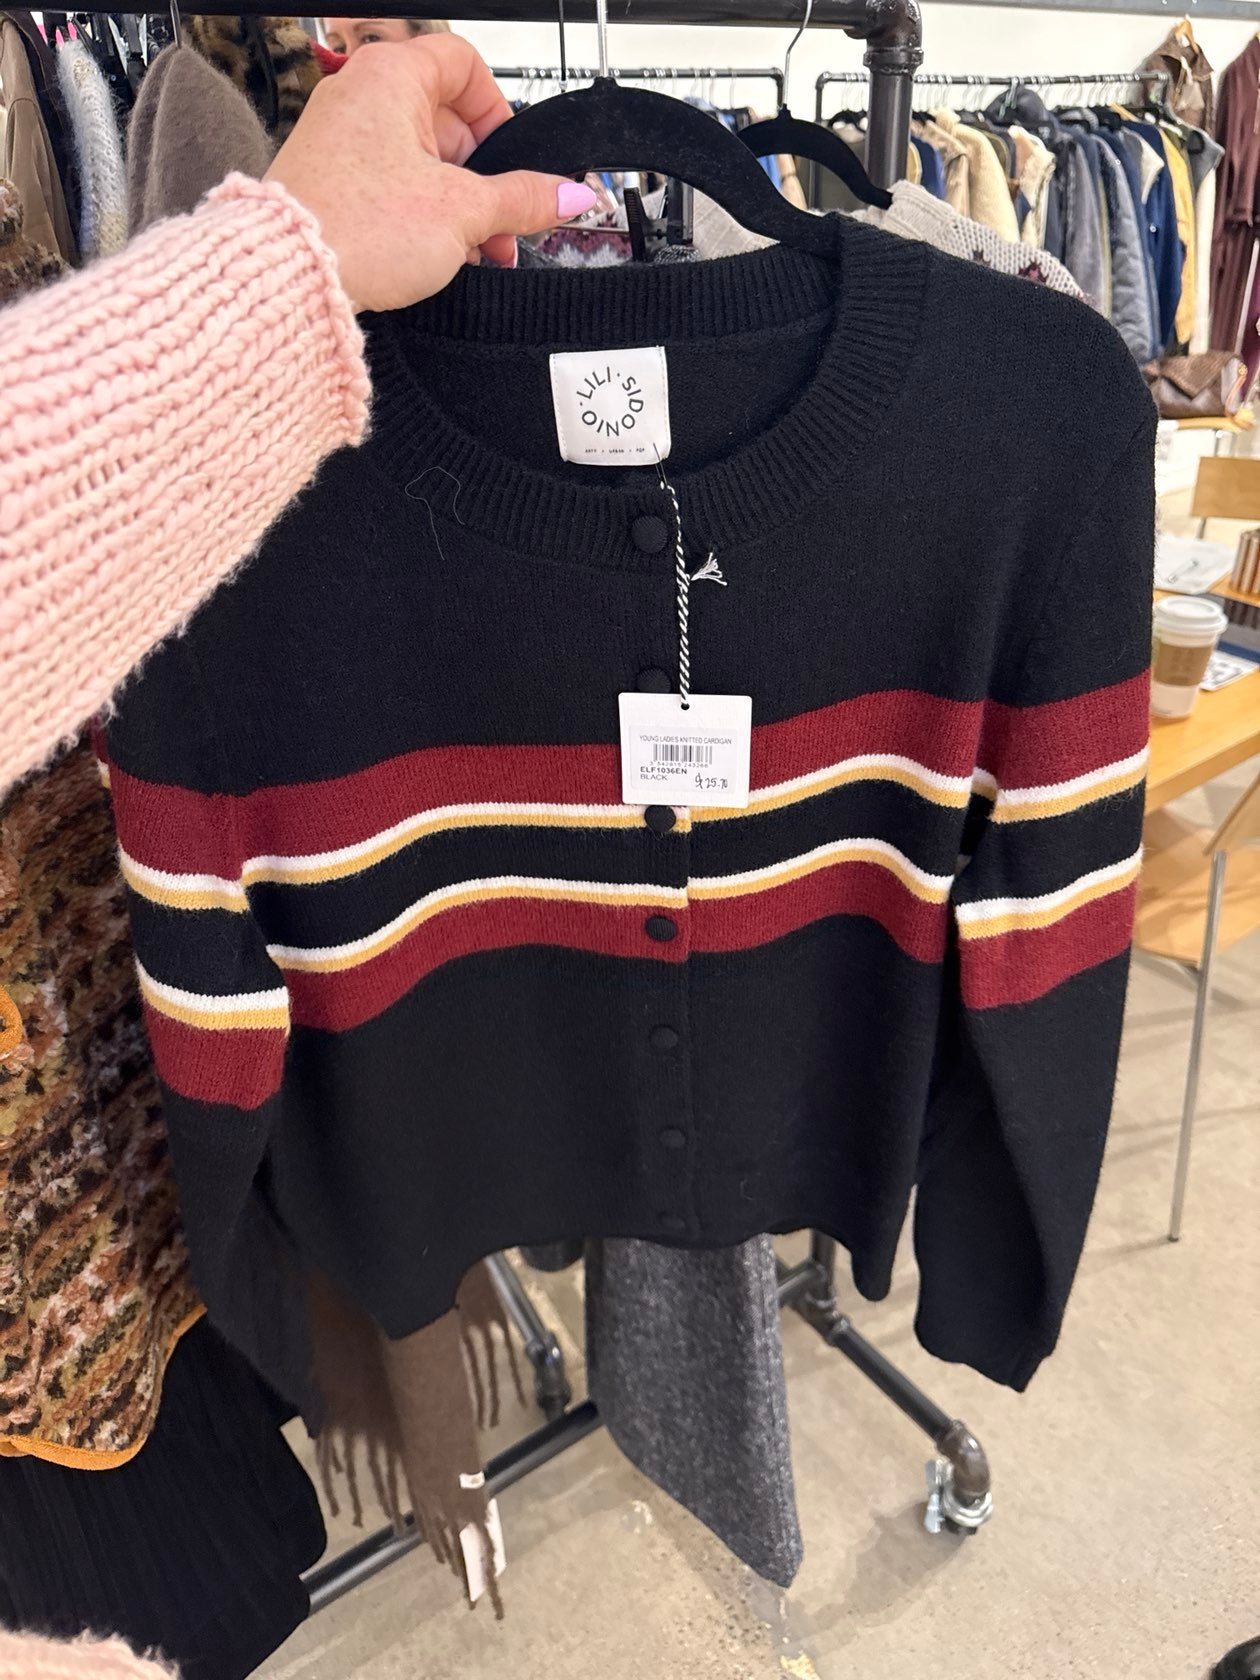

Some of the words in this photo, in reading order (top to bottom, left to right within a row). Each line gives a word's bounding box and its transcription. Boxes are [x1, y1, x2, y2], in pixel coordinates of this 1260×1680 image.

[576, 366, 611, 399] LILI
[582, 376, 644, 437] SIDONIO
[640, 766, 687, 774] ELF1036EN
